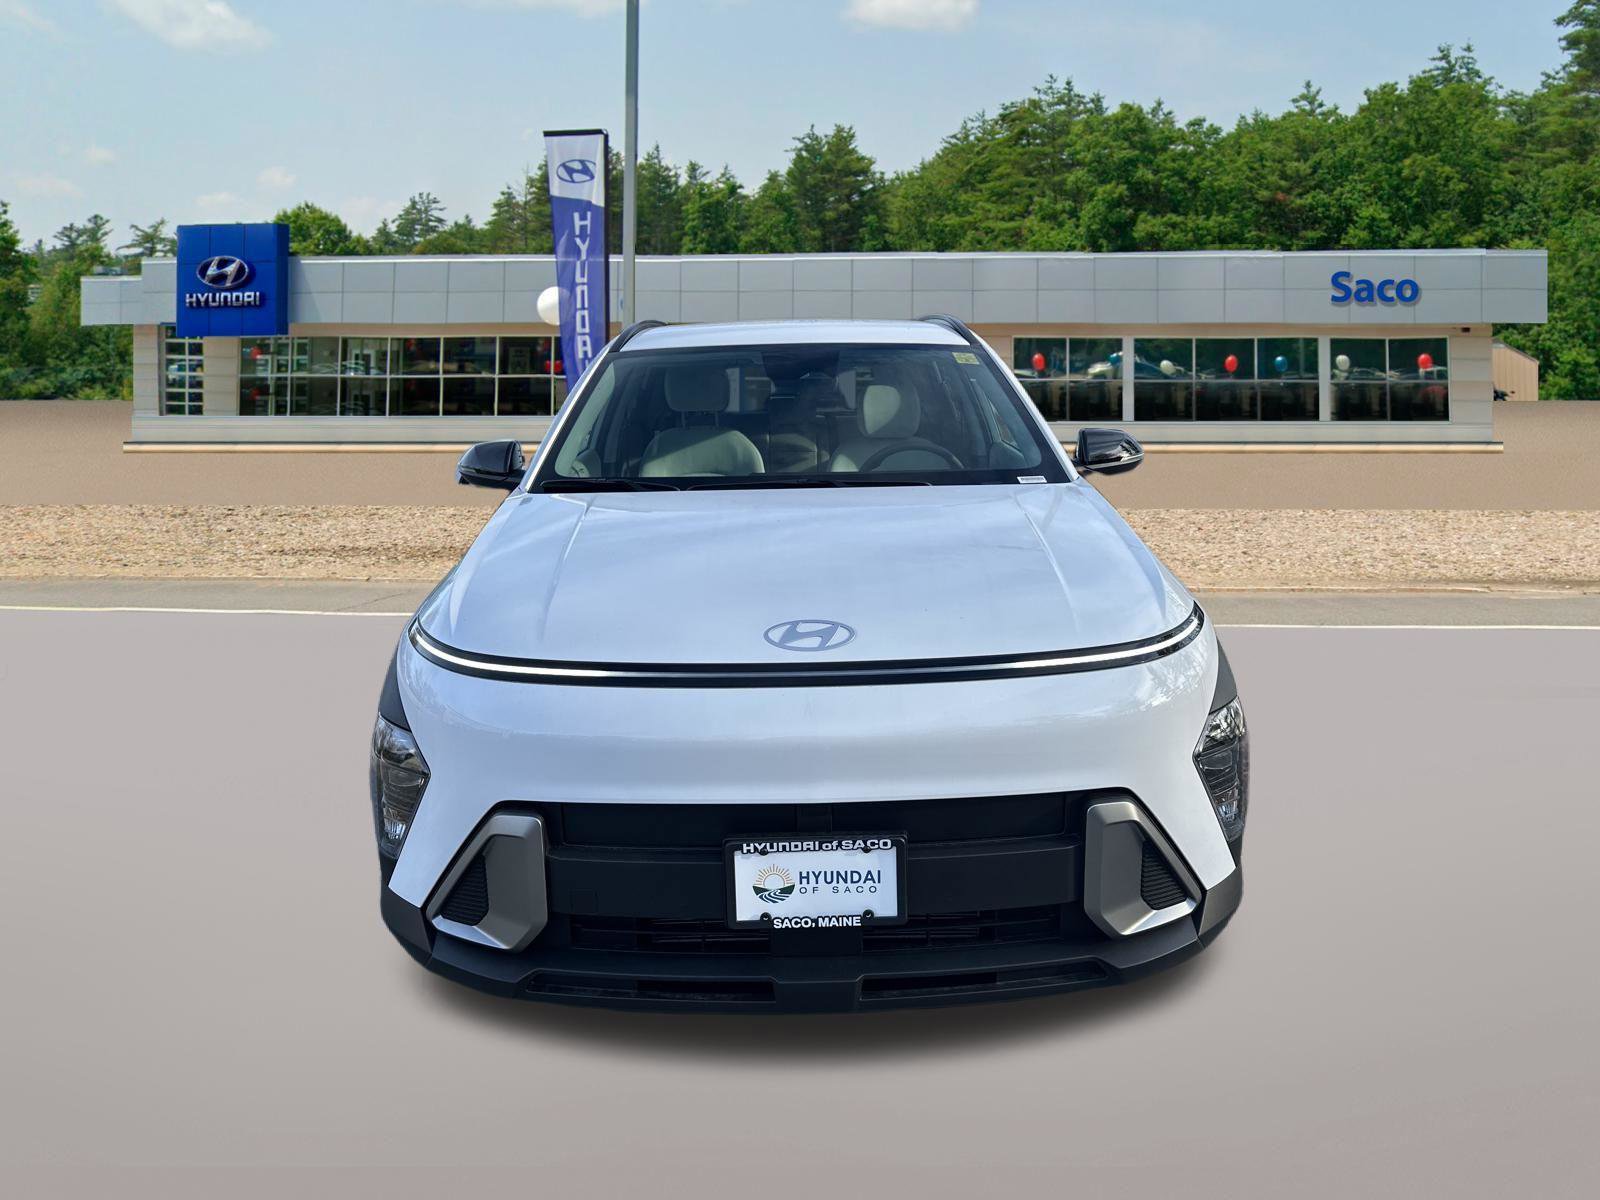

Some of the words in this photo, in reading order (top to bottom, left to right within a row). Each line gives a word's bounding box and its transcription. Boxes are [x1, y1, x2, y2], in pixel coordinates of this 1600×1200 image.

[1330, 270, 1420, 304] Saco
[184, 291, 260, 307] HYUNDAI
[742, 841, 819, 854] HYUNDAI
[822, 840, 839, 850] of
[841, 838, 892, 851] SACO
[799, 870, 881, 885] HYUNDAI
[799, 886, 819, 894] OF
[831, 885, 878, 894] SACO
[773, 917, 816, 929] SACO,
[818, 916, 862, 928] MAINE
